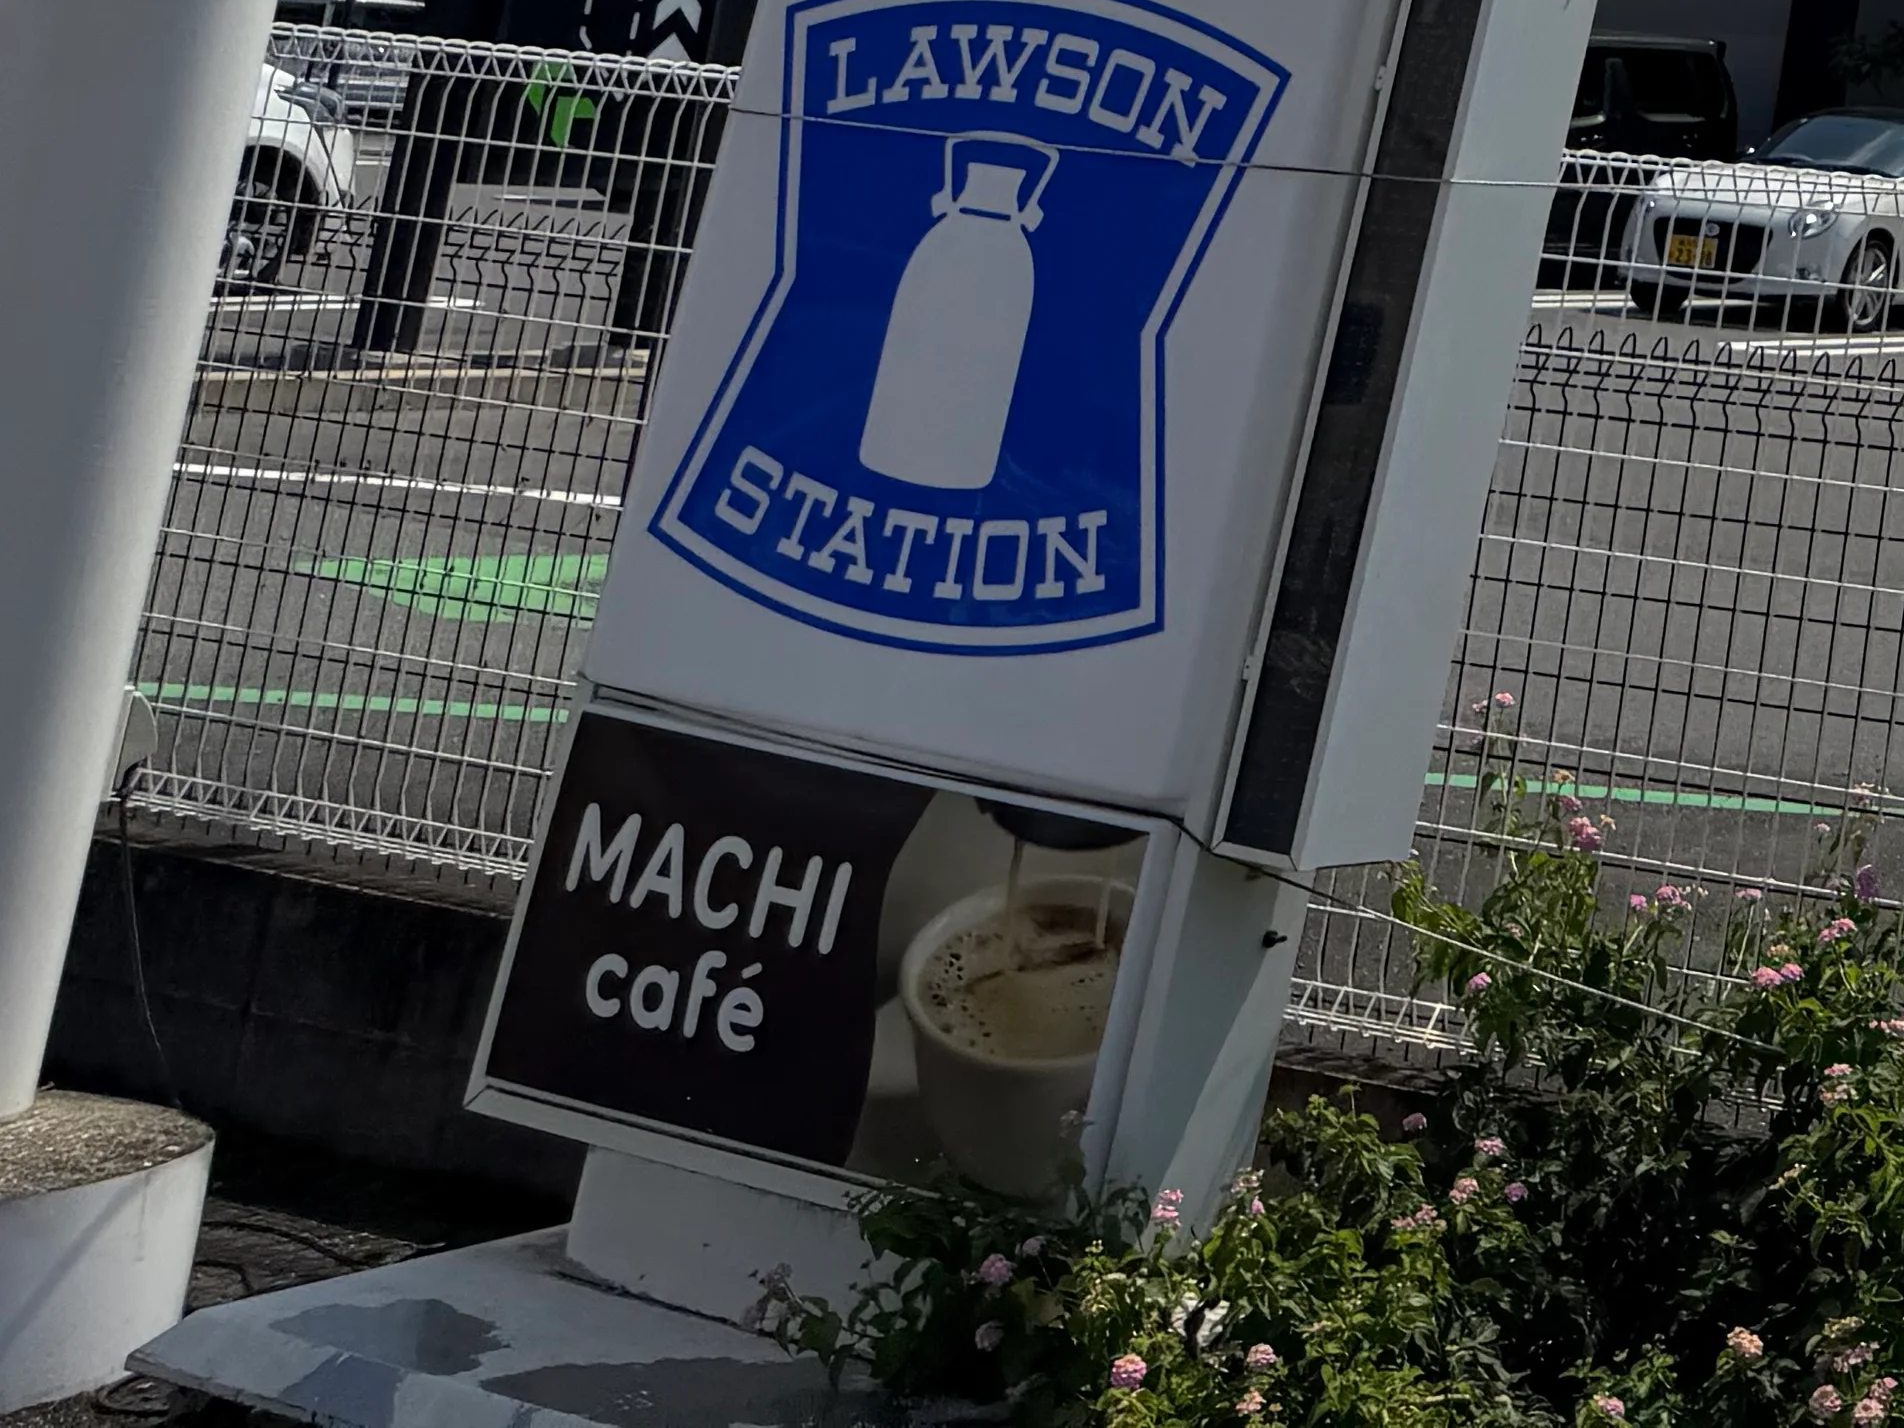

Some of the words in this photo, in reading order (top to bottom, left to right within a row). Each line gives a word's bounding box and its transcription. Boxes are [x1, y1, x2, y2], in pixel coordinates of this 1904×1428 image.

[825, 23, 1229, 168] LAWSON
[714, 446, 1110, 601] STATION
[565, 802, 854, 956] MACHI
[586, 950, 765, 1053] café
